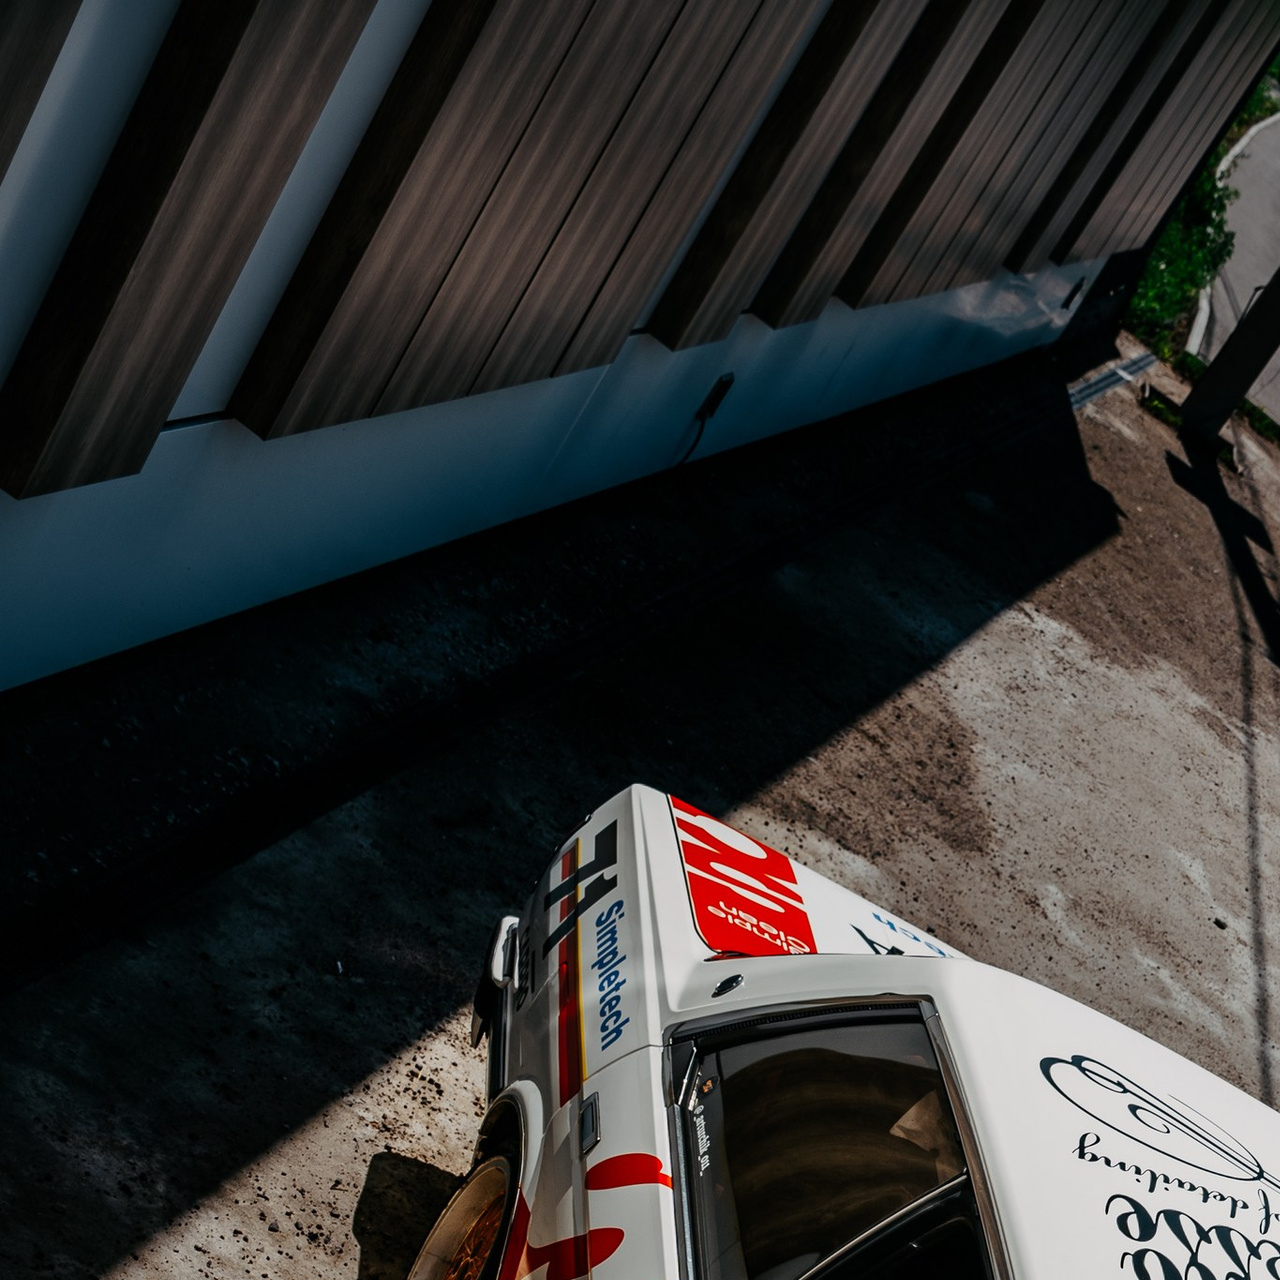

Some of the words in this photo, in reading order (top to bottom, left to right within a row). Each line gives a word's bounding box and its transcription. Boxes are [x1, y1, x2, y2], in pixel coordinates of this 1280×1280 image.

[542, 818, 618, 961] 71
[719, 901, 811, 953] Clean
[595, 899, 630, 1052] Simpletech
[1071, 1132, 1249, 1218] detailing
